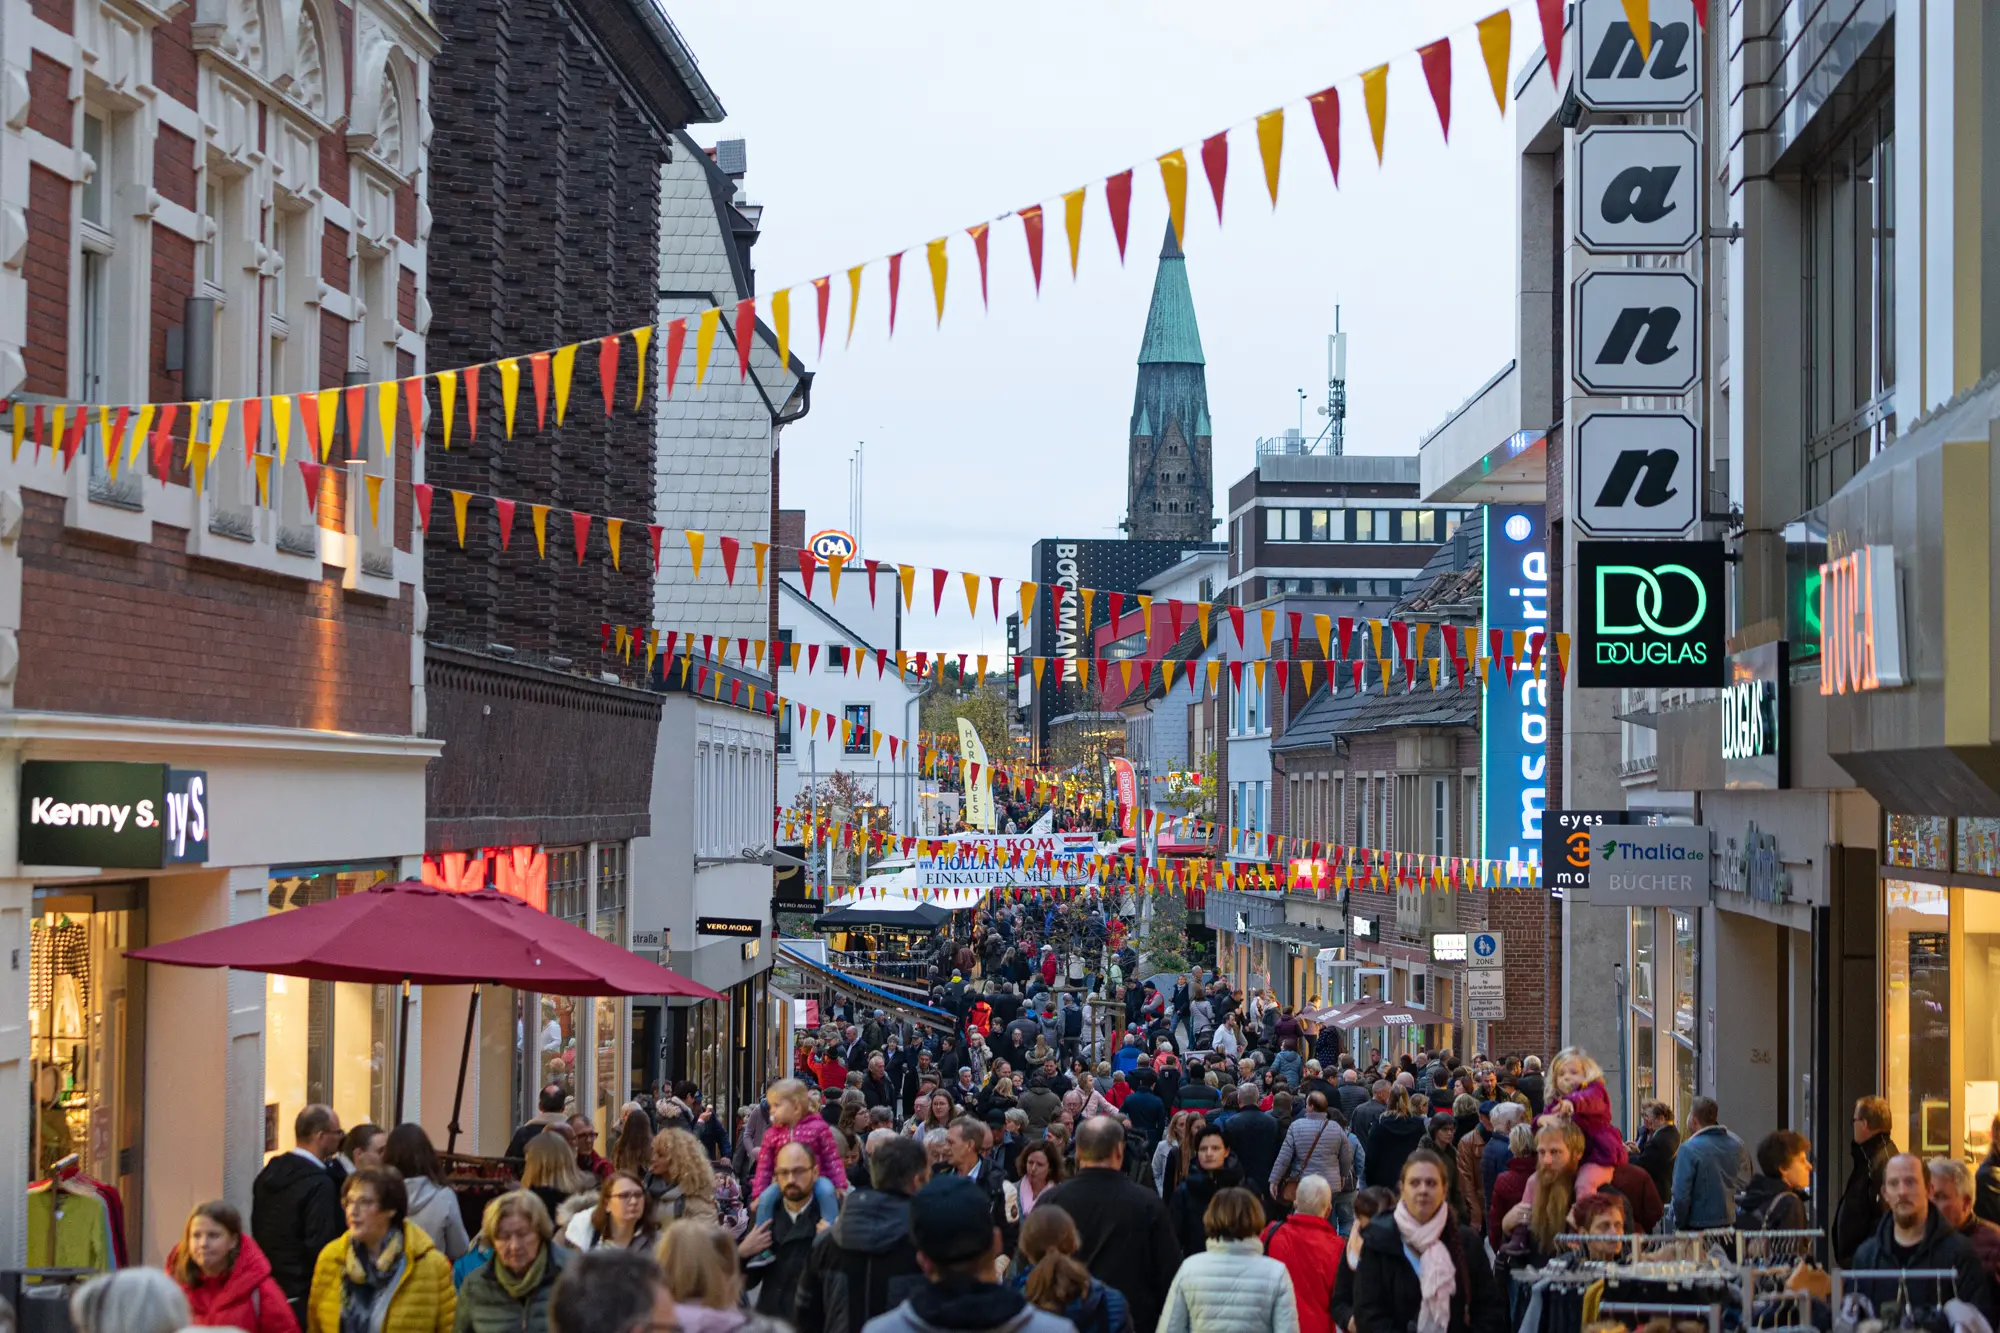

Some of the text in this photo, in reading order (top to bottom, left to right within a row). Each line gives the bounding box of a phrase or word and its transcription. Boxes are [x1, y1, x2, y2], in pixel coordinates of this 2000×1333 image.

[817, 538, 848, 556] C&A
[1596, 642, 1708, 665] DOUGLAS
[1721, 678, 1764, 760] DOUGLAS
[31, 796, 160, 833] Kenny S.
[1559, 814, 1603, 830] eyes
[925, 870, 1052, 885] EINKAUFEN MIT
[1557, 872, 1590, 884] mo
[1609, 870, 1693, 891] BÜCHER
[728, 924, 753, 932] MODA
